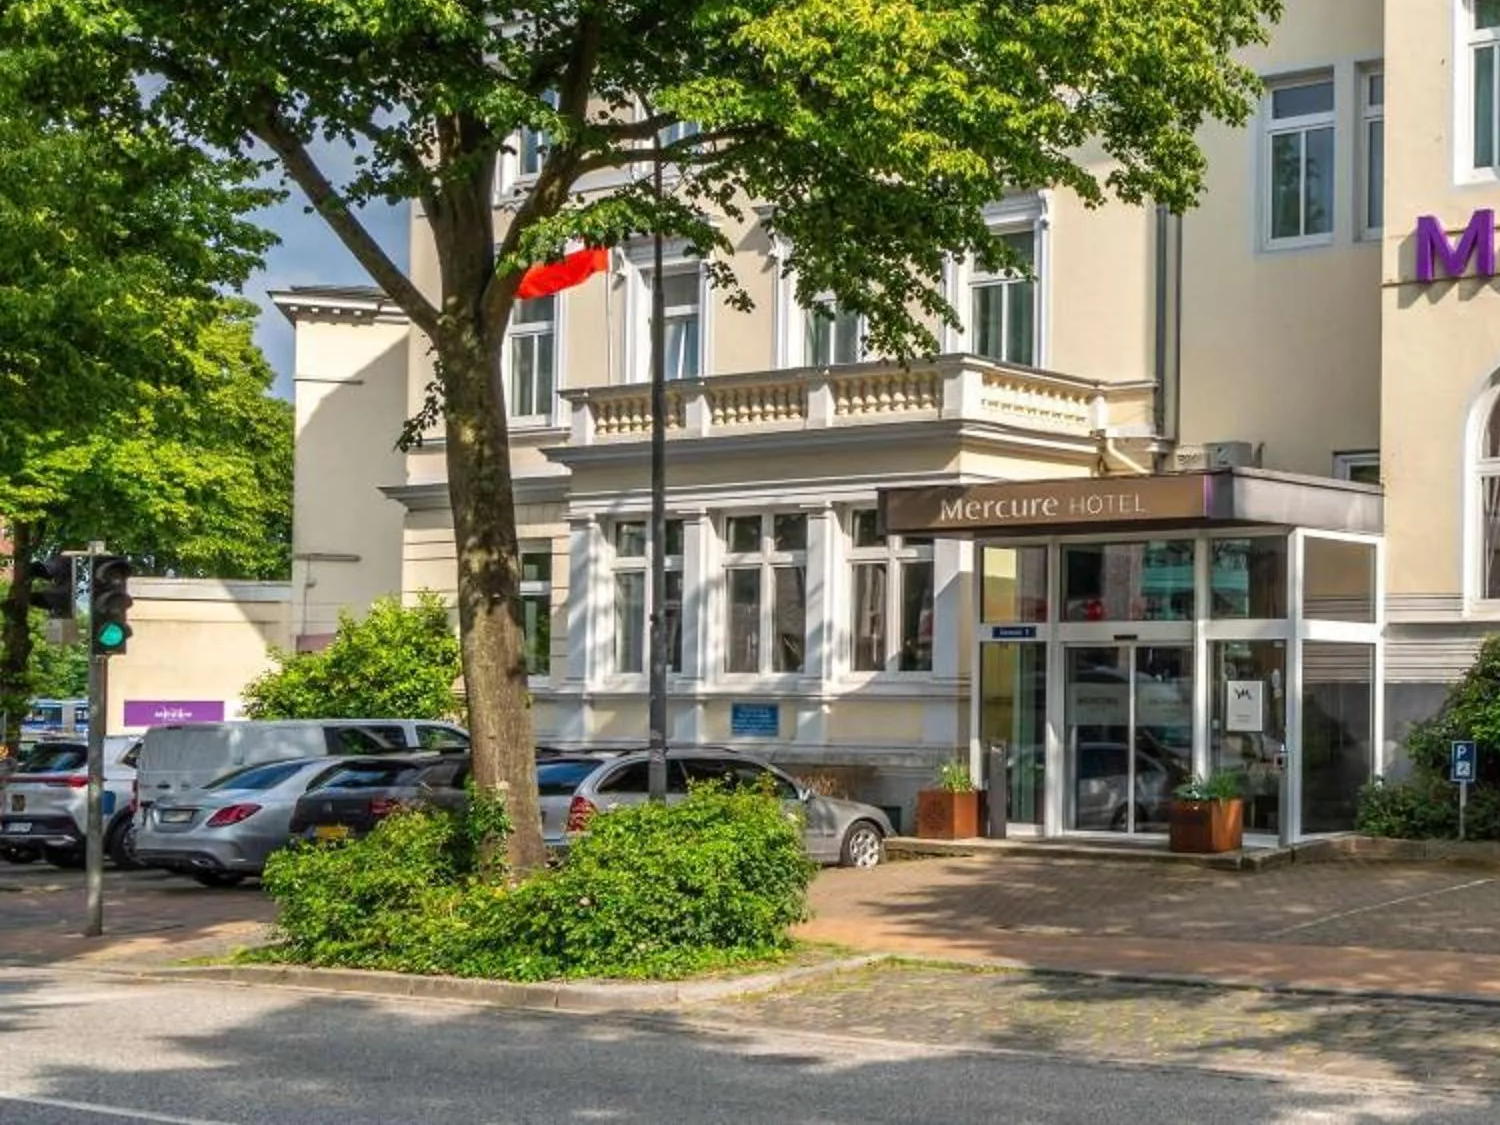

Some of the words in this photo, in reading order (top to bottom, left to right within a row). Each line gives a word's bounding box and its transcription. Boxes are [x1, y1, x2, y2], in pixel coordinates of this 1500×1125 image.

[940, 495, 1059, 521] Mercure
[1069, 492, 1147, 515] HOTEL
[1457, 744, 1467, 759] P
